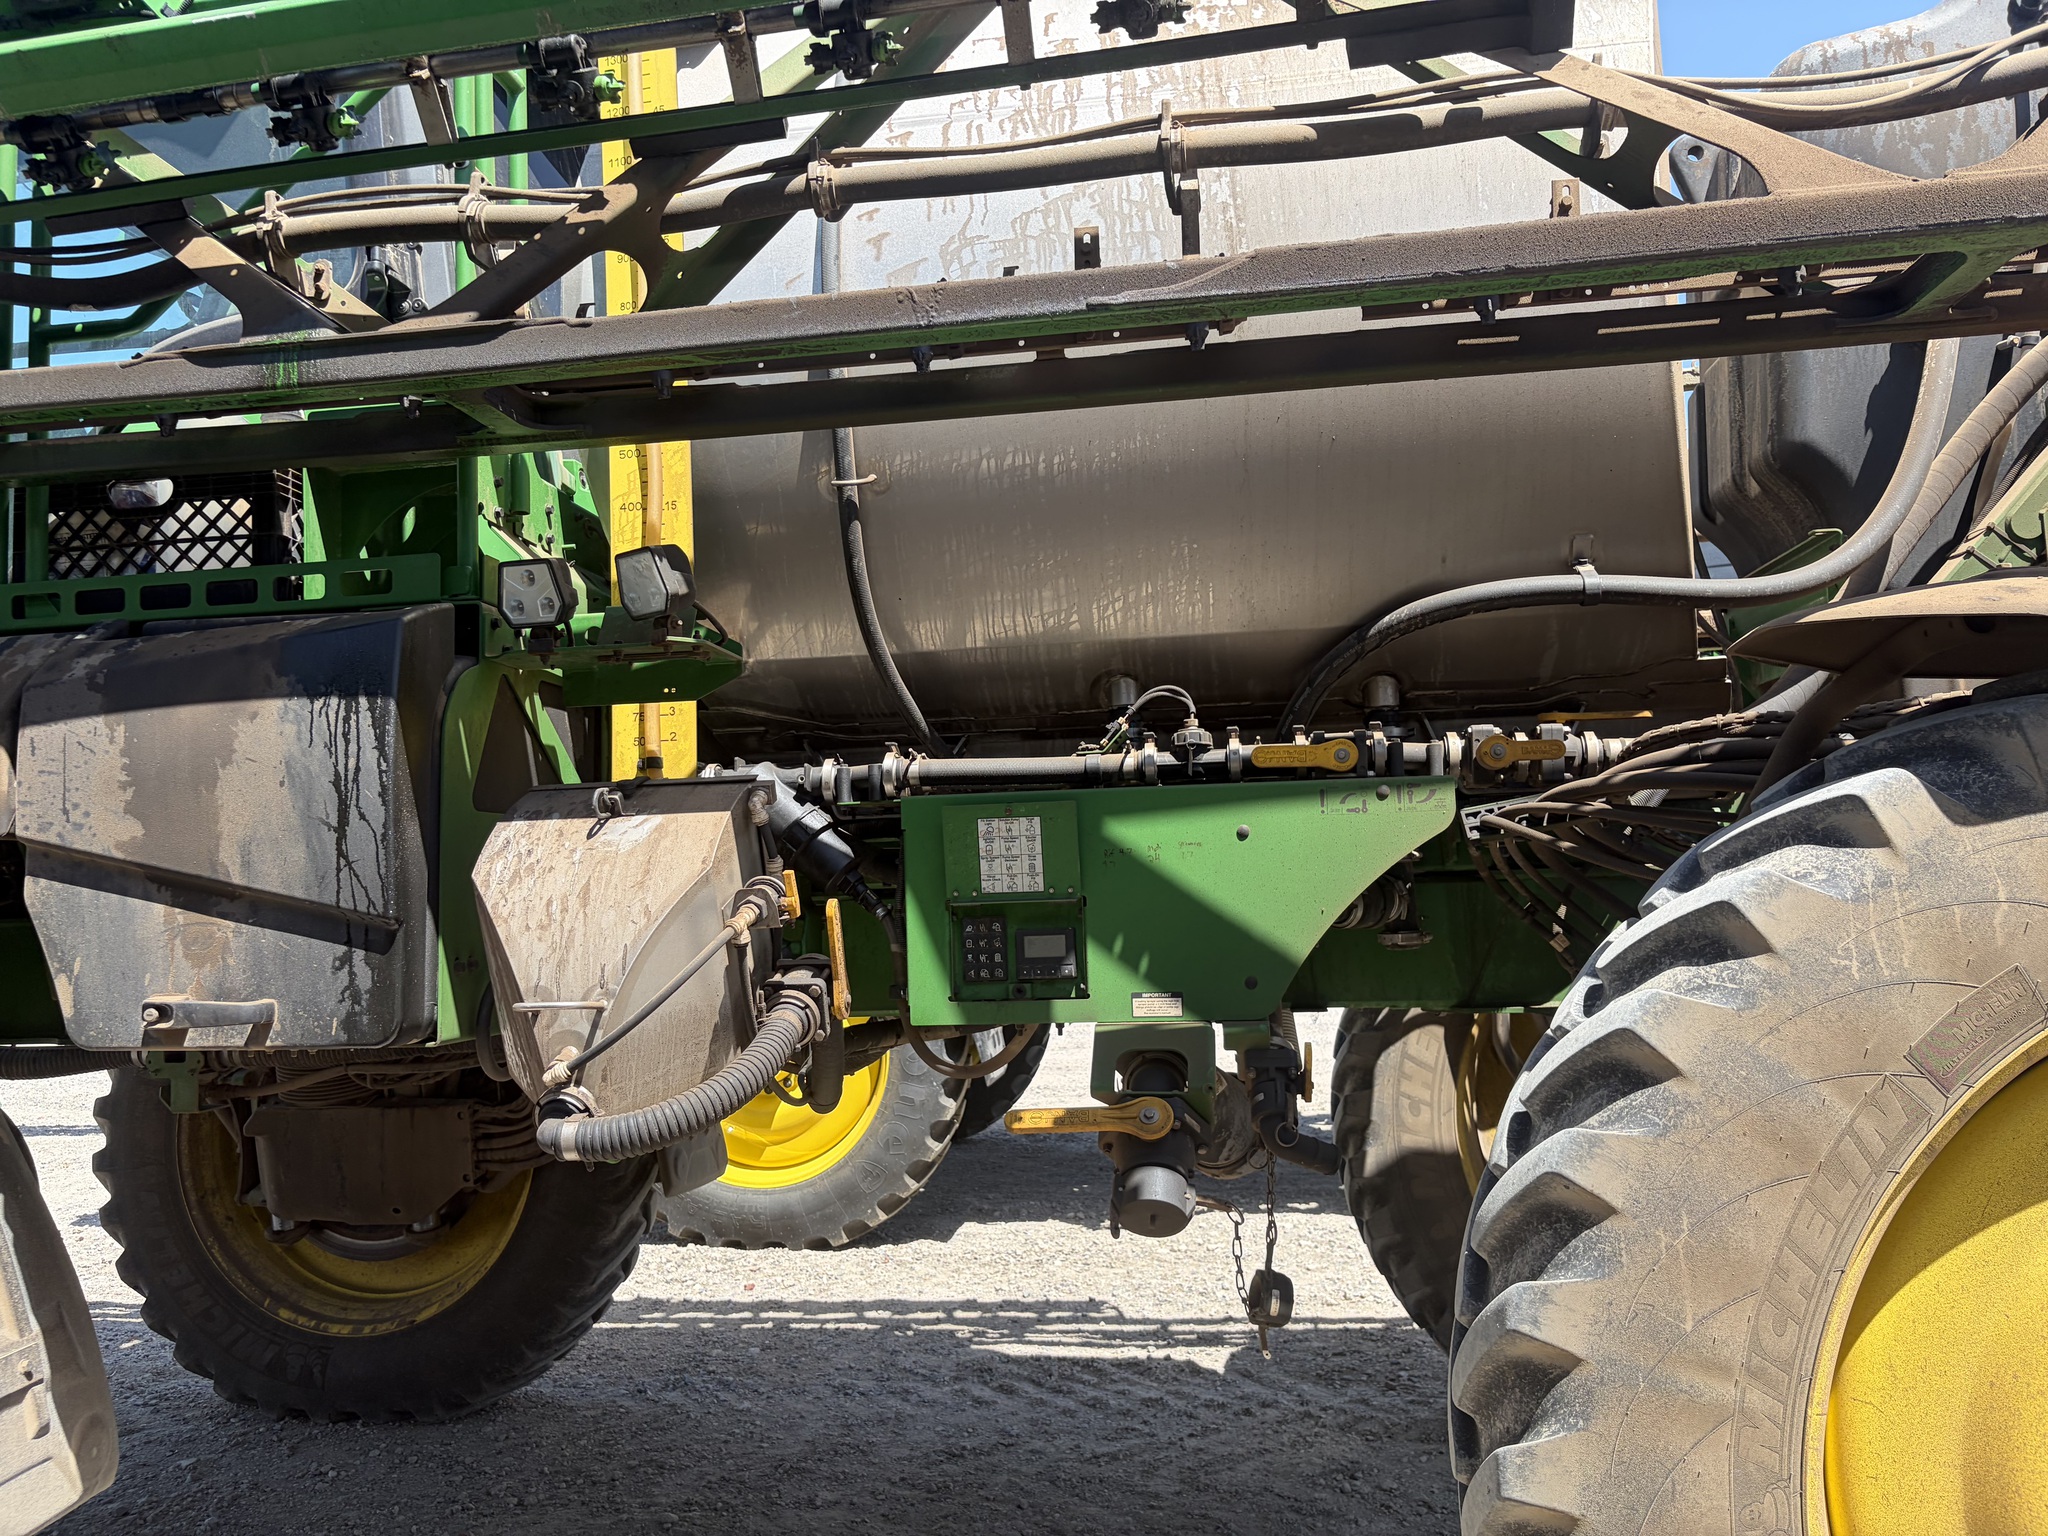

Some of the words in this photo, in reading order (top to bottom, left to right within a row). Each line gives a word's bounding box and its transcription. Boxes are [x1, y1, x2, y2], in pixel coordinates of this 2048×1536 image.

[605, 54, 628, 66] 1300
[607, 105, 630, 117] 1200
[609, 156, 632, 168] 1100
[620, 300, 636, 311] 800
[619, 448, 641, 460] 500
[620, 501, 643, 512] 400
[665, 500, 677, 511] 15
[633, 711, 645, 722] 75
[669, 706, 676, 716] 3
[633, 736, 646, 747] 50
[669, 731, 678, 742] 2
[1952, 979, 2027, 1045] MICHELIN
[1028, 1110, 1089, 1126] BANJO
[1738, 1081, 1910, 1474] MICHELIN
